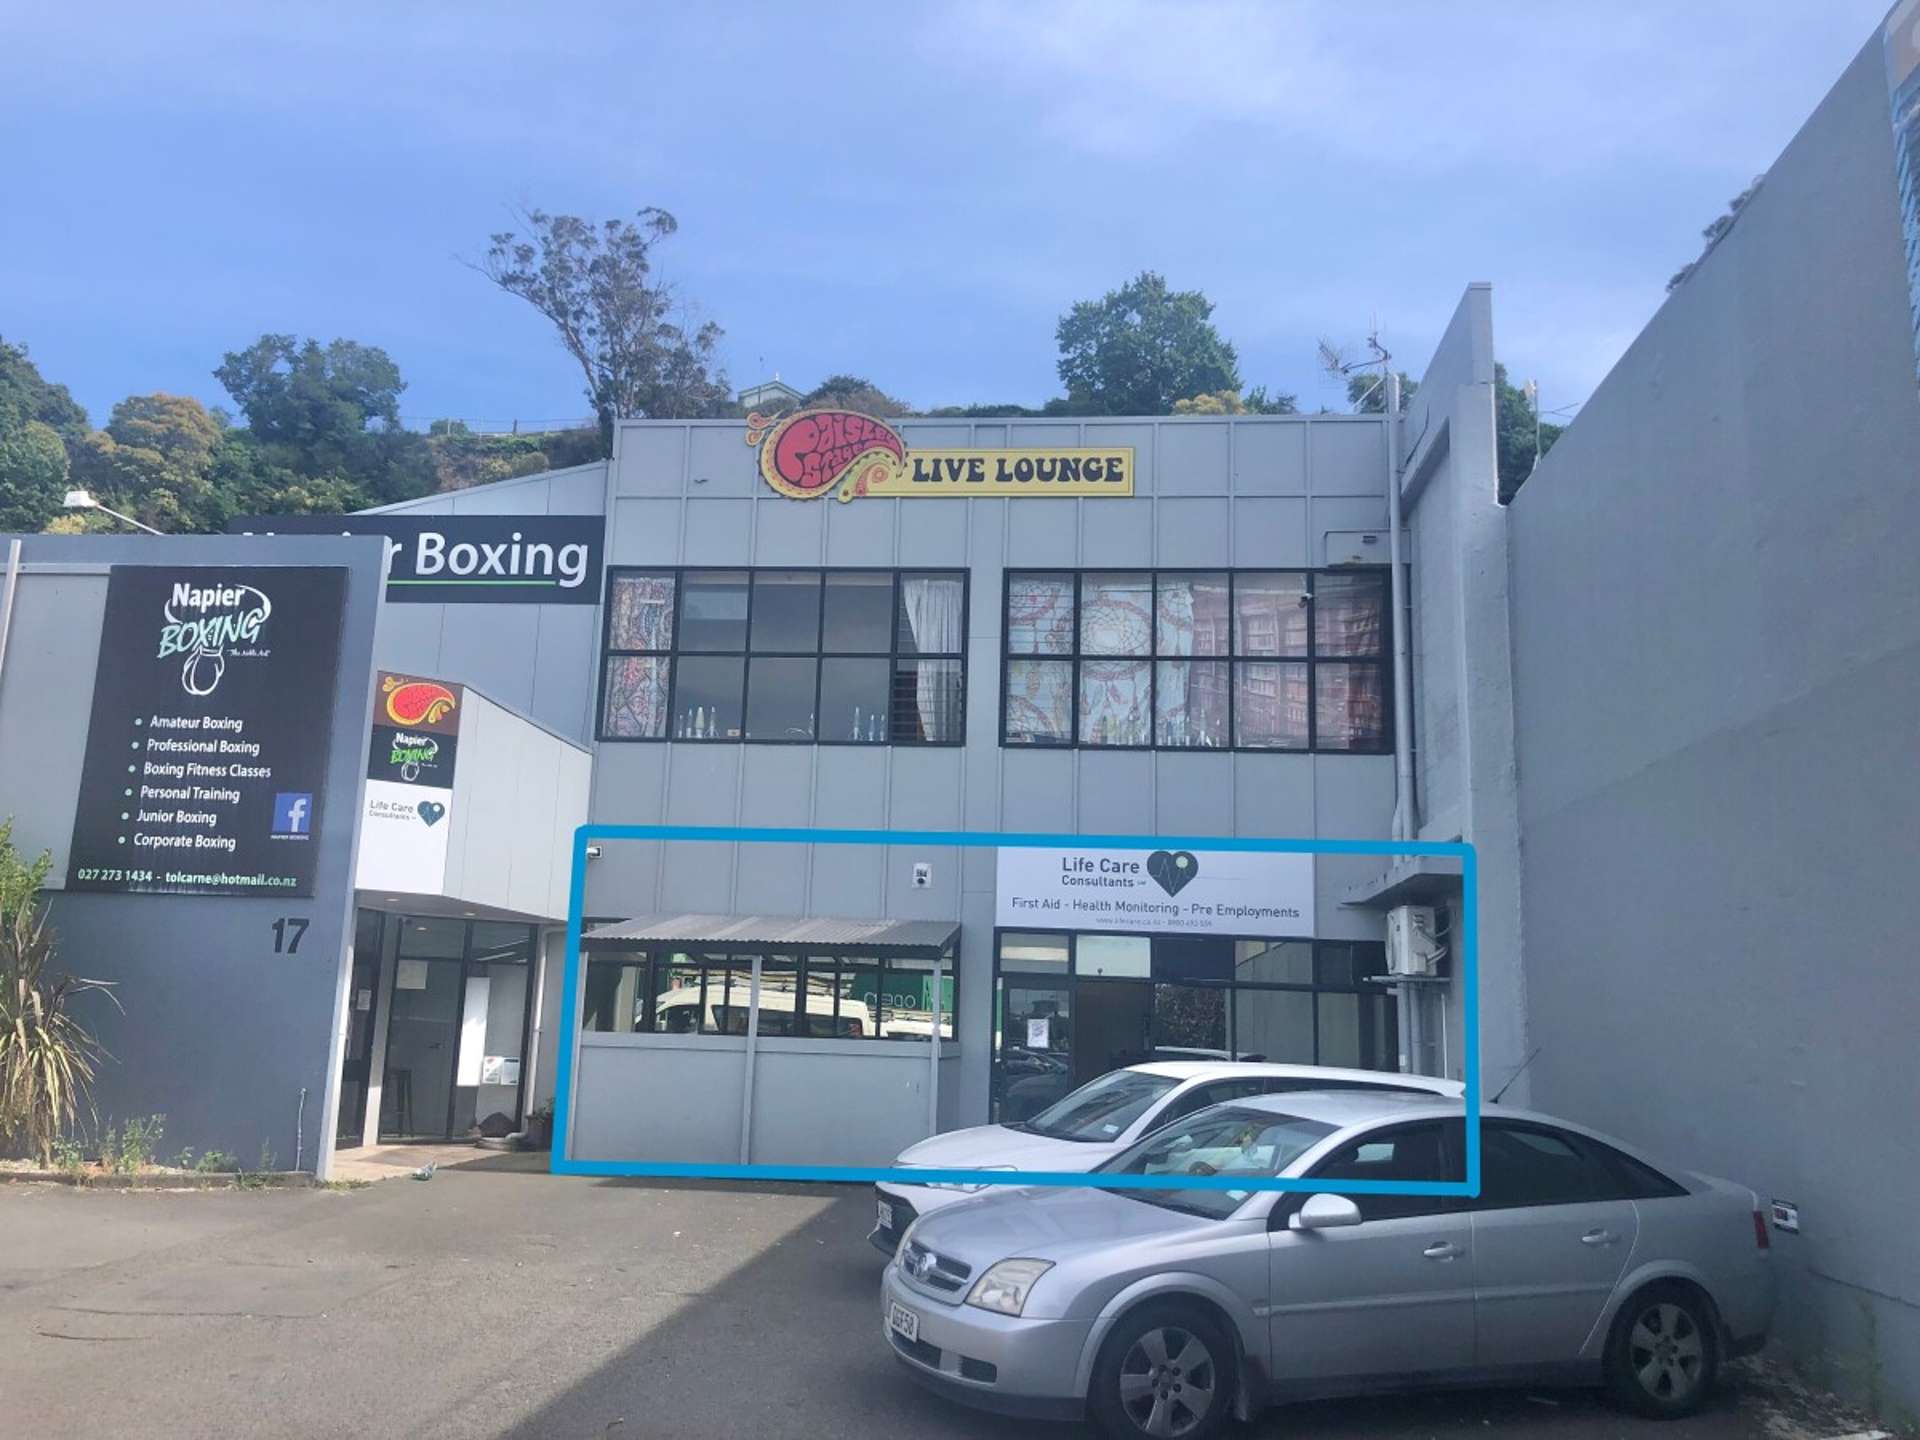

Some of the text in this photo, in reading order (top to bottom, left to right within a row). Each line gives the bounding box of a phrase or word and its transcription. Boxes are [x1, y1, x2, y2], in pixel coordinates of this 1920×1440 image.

[911, 456, 1124, 483] LIVE LOUNGE
[415, 531, 589, 588] Boxing
[172, 582, 246, 614] Napier
[157, 608, 264, 659] BOXING
[150, 715, 244, 733] Amateur Boxing
[146, 738, 260, 757] Professional Boxing
[143, 762, 272, 779] Boxing Fitness Classes
[140, 785, 241, 804] Personal Training
[391, 802, 414, 813] Care
[136, 809, 217, 828] Junior Boxing
[133, 833, 237, 852] Corporate Boxing
[1062, 856, 1140, 874] Life Care
[77, 869, 99, 881] 027
[100, 869, 122, 881] 273
[125, 870, 153, 882] 1434
[165, 871, 297, 887] tolcarne@hotmail.co.nz
[1062, 874, 1135, 888] Consultants
[1012, 896, 1040, 910] First
[1041, 898, 1061, 910] Aid
[1072, 898, 1112, 912] Health
[1114, 900, 1179, 917] Monitoring
[1191, 903, 1213, 916] Pre
[1216, 903, 1300, 919] Employments
[271, 917, 310, 955] 17
